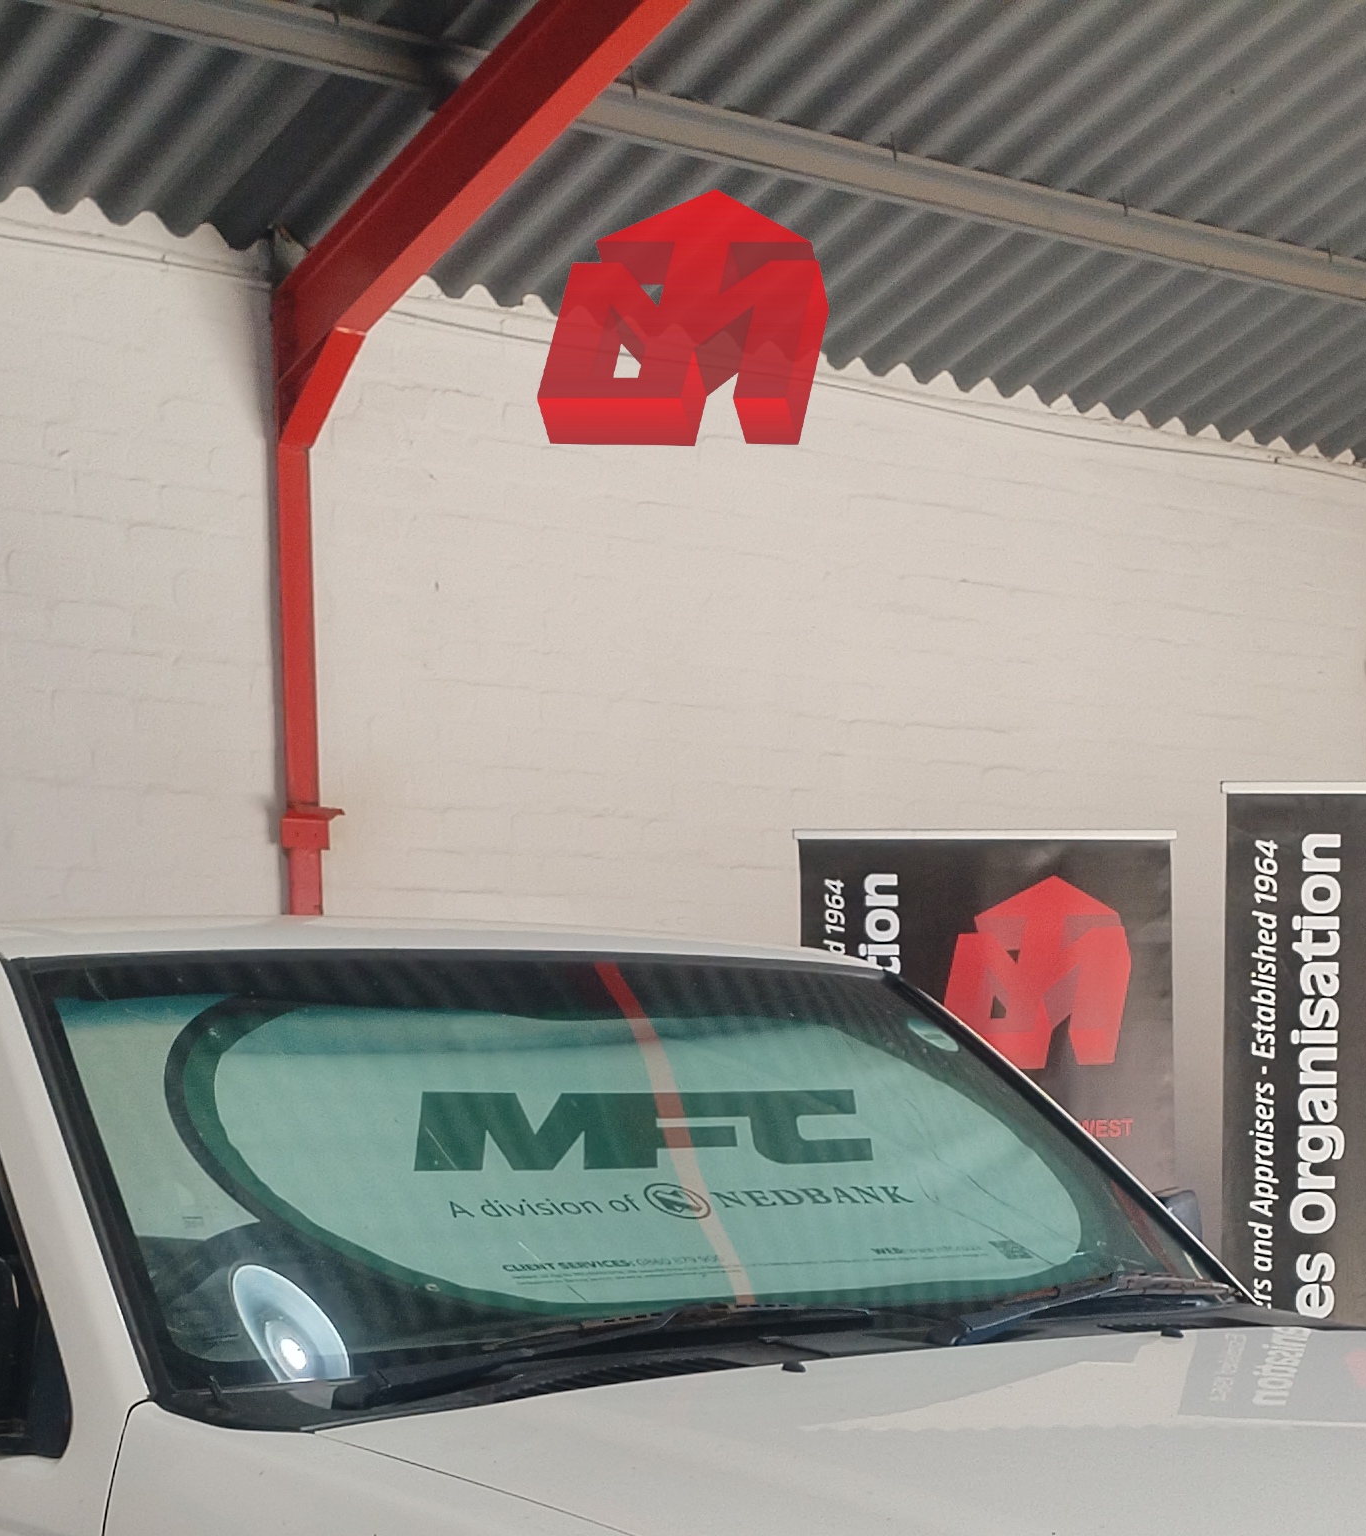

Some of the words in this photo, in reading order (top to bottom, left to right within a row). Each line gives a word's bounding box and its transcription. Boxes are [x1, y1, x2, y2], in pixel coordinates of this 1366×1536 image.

[1254, 839, 1279, 904] 1964
[824, 878, 846, 934] 1964
[1250, 911, 1279, 1059] Established
[1289, 833, 1345, 1235] Organisation
[414, 1089, 873, 1172] MFC
[1248, 1081, 1280, 1218] Appraisers
[448, 1200, 476, 1219] A
[479, 1197, 604, 1219] division
[607, 1193, 642, 1214] of
[709, 1185, 915, 1209] NEDBANK
[1247, 1221, 1274, 1272] and
[1252, 1278, 1273, 1309] rs
[1295, 1252, 1336, 1319] es
